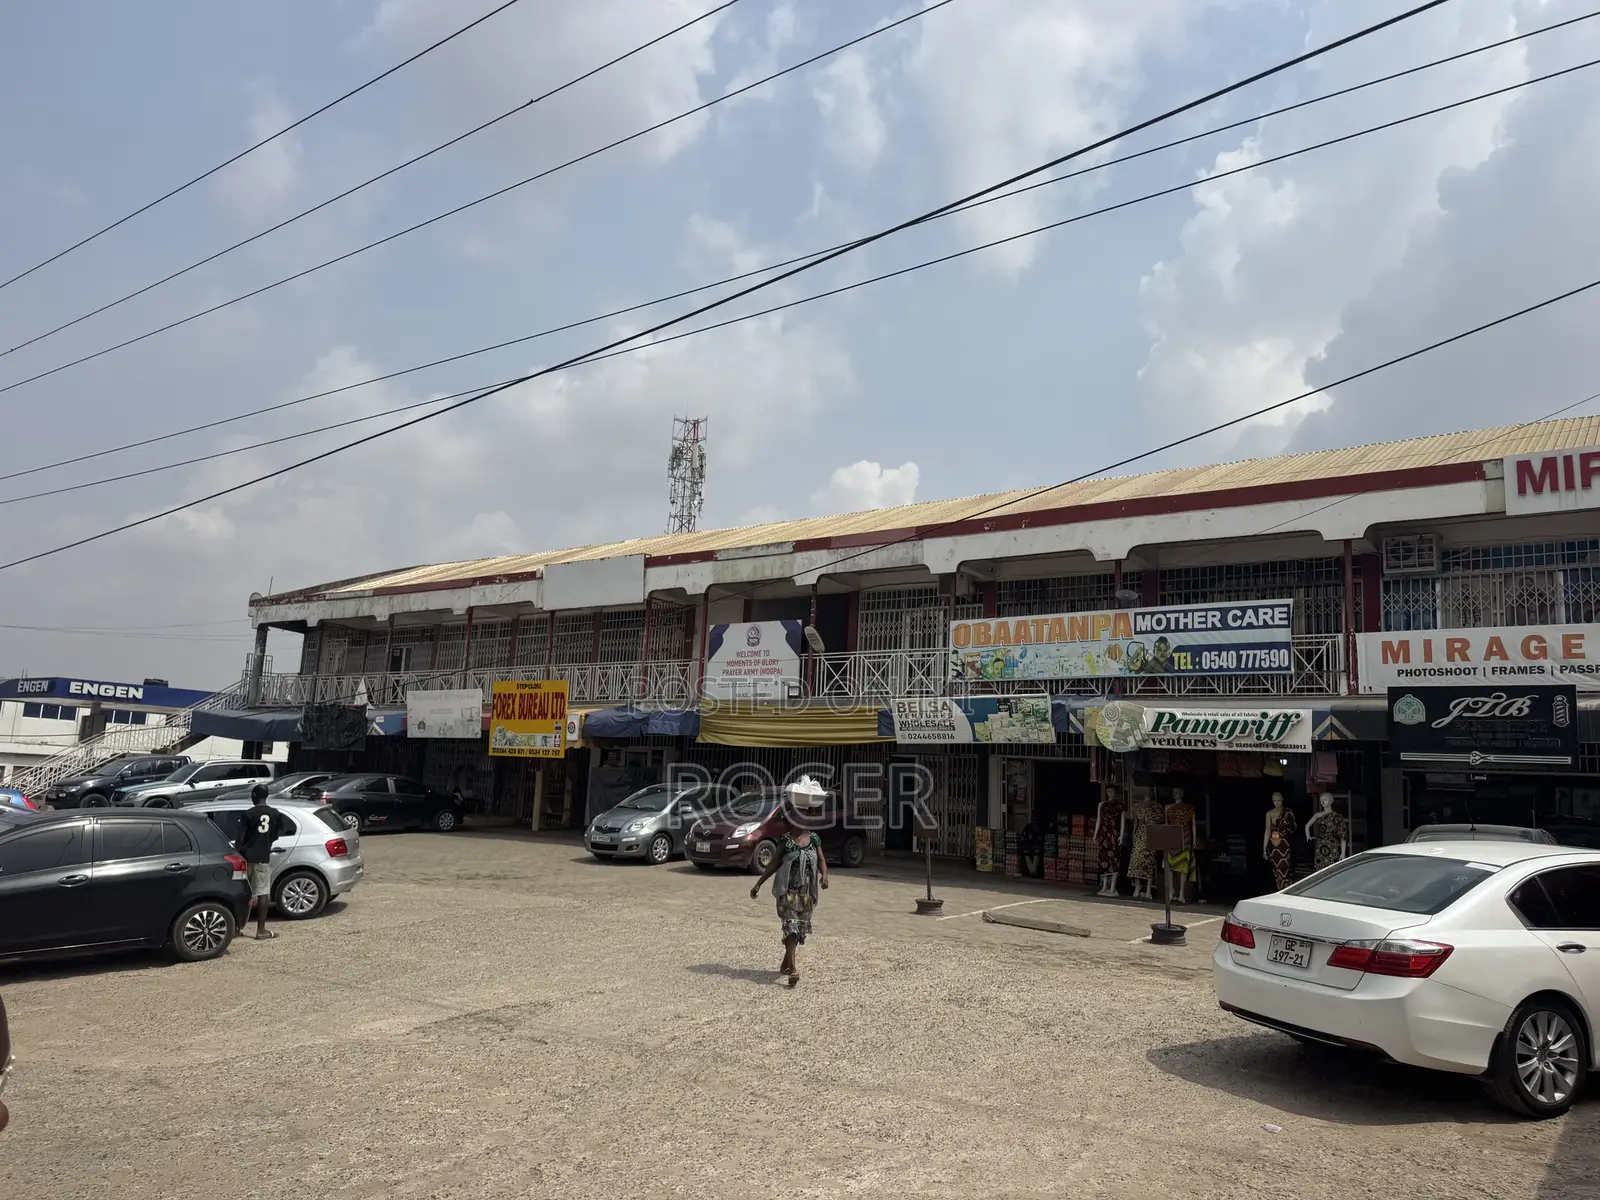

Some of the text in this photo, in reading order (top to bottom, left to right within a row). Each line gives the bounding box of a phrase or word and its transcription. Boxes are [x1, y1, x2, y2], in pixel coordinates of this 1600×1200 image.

[953, 607, 1289, 649] OBAATANPA MOTHER CARE
[736, 650, 762, 658] WELCOME
[1381, 634, 1586, 665] MIRAGE
[726, 658, 780, 667] MOMENTS OF GLORY
[1201, 650, 1237, 670] 0540
[1240, 649, 1289, 669] 777590
[722, 668, 742, 676] PRAYER
[743, 668, 758, 676] ARMY
[1397, 666, 1478, 678] PHOTOSHOOT
[1491, 665, 1546, 675] FRAMES
[17, 680, 49, 693] ENGEN
[69, 681, 144, 700] ENGEN
[492, 692, 517, 720] FOREX
[518, 692, 550, 720] BUREAU
[897, 701, 952, 713] BELSA
[899, 720, 955, 728] WHOLESALE
[1149, 711, 1302, 742] Pamgriff
[1151, 736, 1217, 748] ventures
[257, 814, 270, 833] 3
[1272, 949, 1304, 966] 197-21
